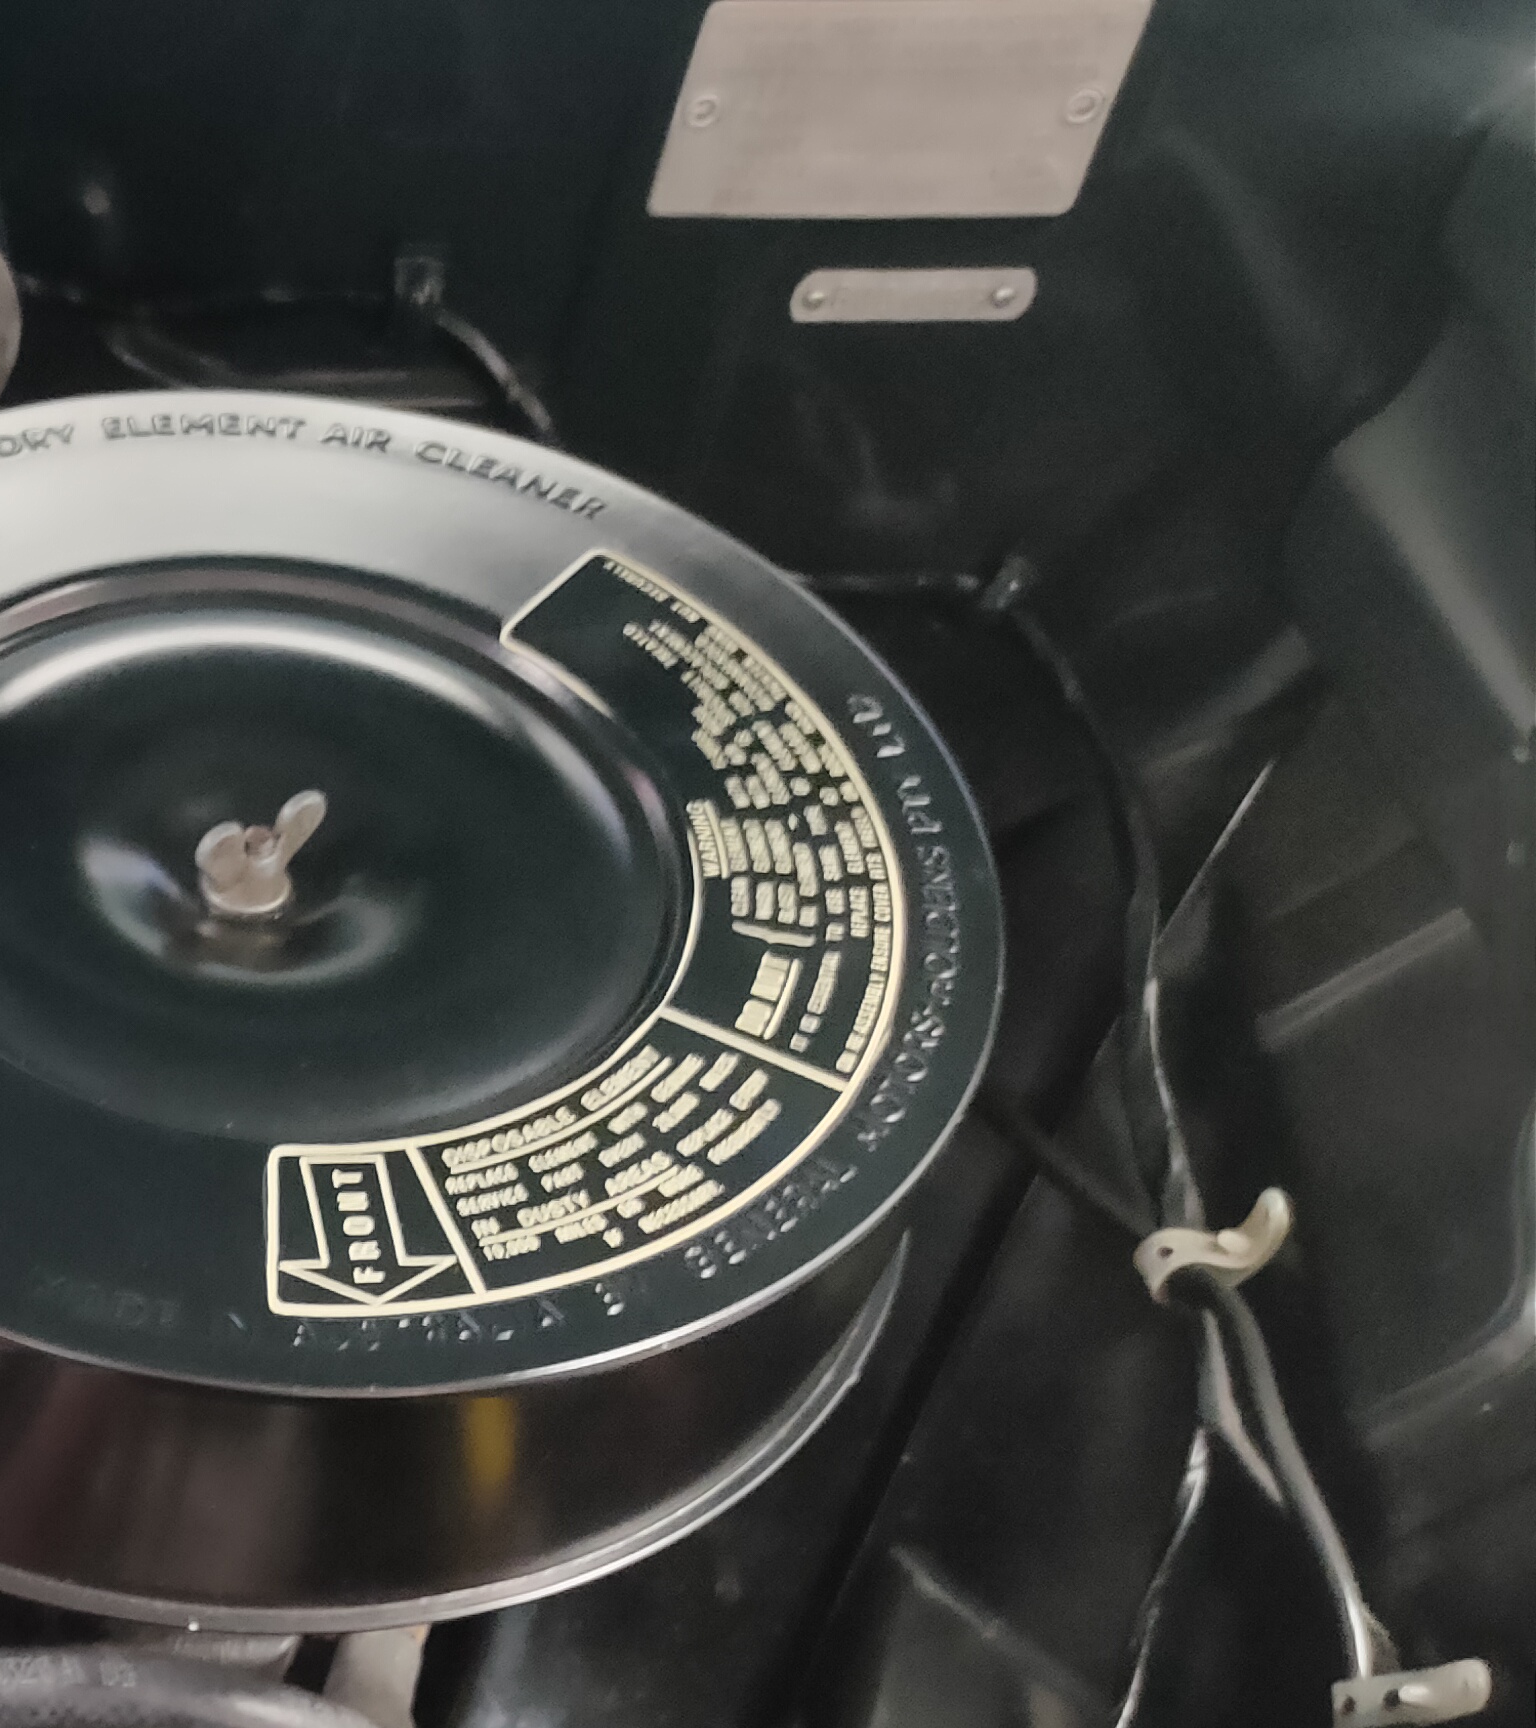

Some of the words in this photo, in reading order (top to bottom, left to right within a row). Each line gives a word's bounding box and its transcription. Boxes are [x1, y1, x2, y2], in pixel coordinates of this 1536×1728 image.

[103, 412, 307, 441] ELEMENT
[324, 419, 394, 456] AIR
[414, 439, 611, 522] CLEANER
[686, 800, 722, 878] WARNING
[332, 1168, 387, 1284] FRONT
